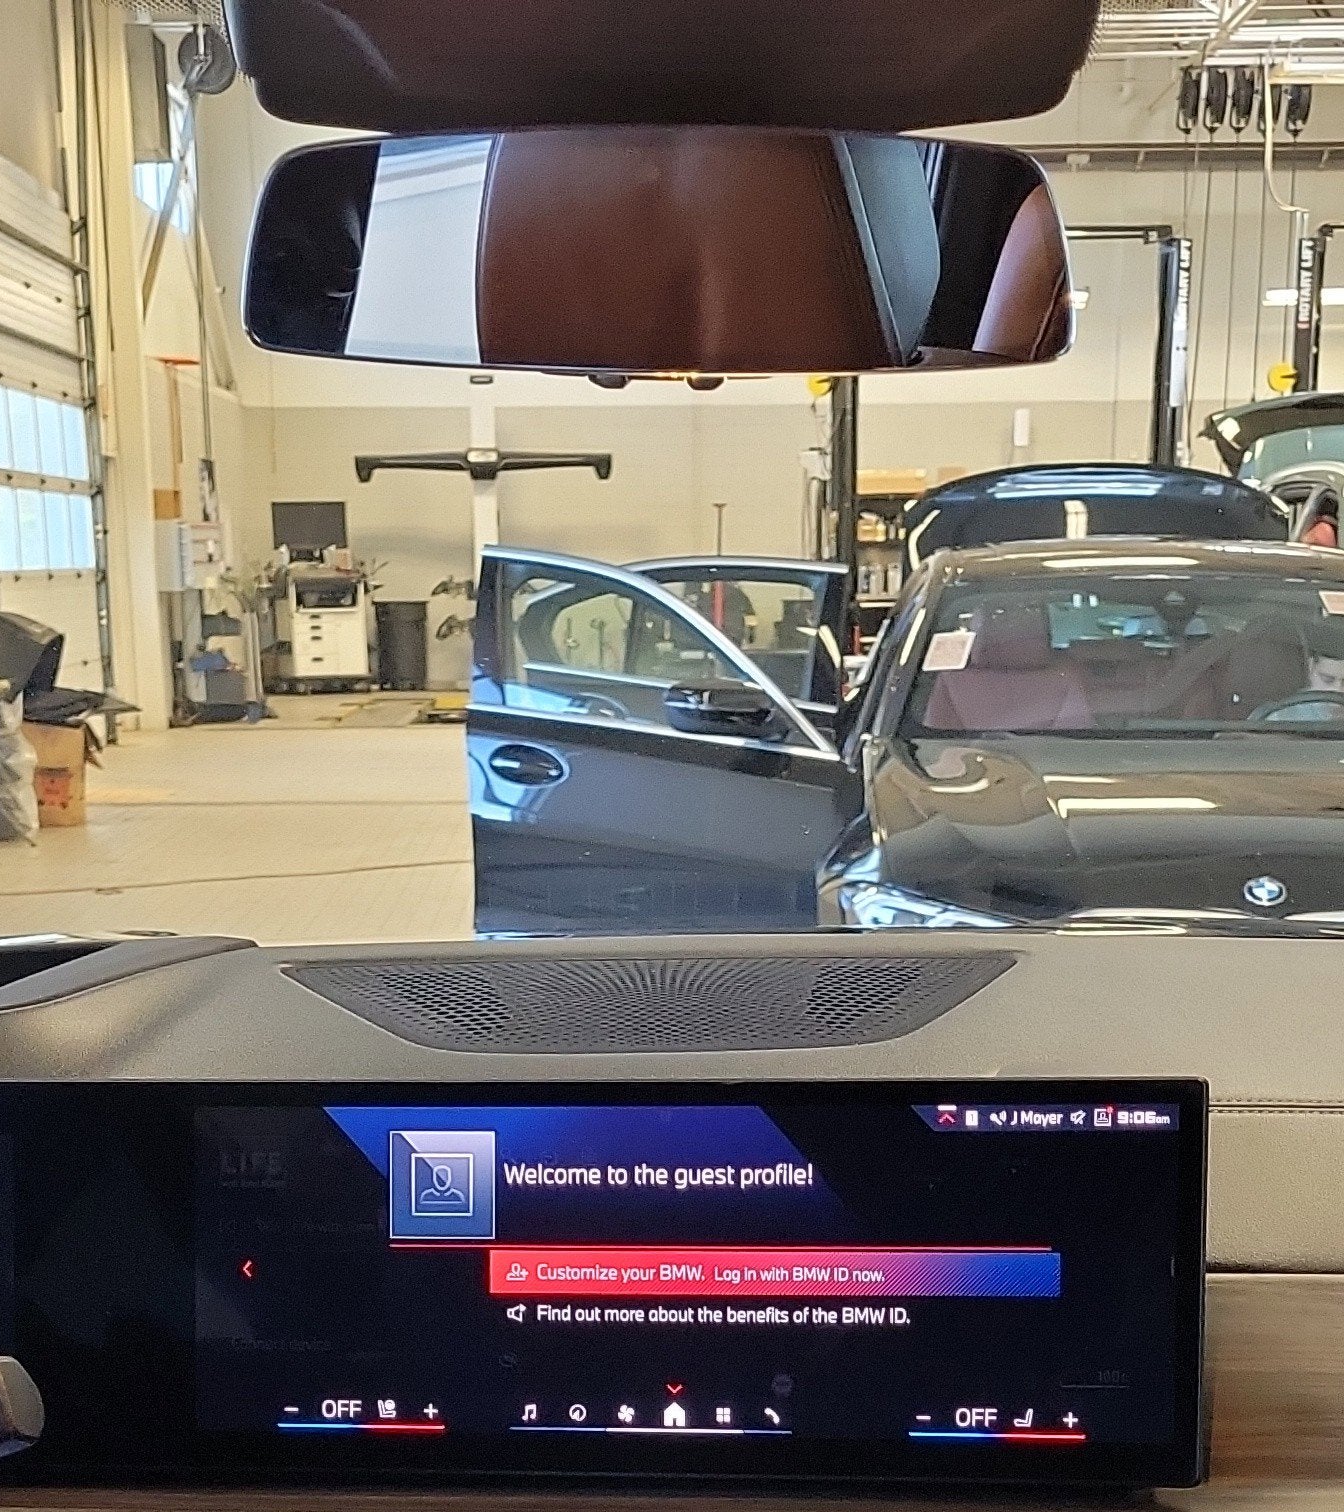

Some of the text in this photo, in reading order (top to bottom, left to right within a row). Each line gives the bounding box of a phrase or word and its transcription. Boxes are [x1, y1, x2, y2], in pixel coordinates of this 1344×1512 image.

[1298, 240, 1314, 322] ROTARY LIFT
[1020, 1110, 1063, 1126] Mayer
[1117, 1111, 1170, 1125] 9:06am
[504, 1163, 813, 1189] Welcome to the guest profile!
[536, 1263, 618, 1281] Customize
[621, 1267, 656, 1283] your
[659, 1264, 705, 1281] BMW.
[714, 1266, 741, 1284] Log
[760, 1266, 789, 1281] with
[792, 1266, 830, 1281] BMW
[833, 1267, 848, 1281] ID
[852, 1269, 885, 1282] now.
[536, 1304, 911, 1323] Find out more about the benefits of the BMW ID.
[321, 1400, 362, 1418] OFF
[956, 1408, 998, 1427] OFF
